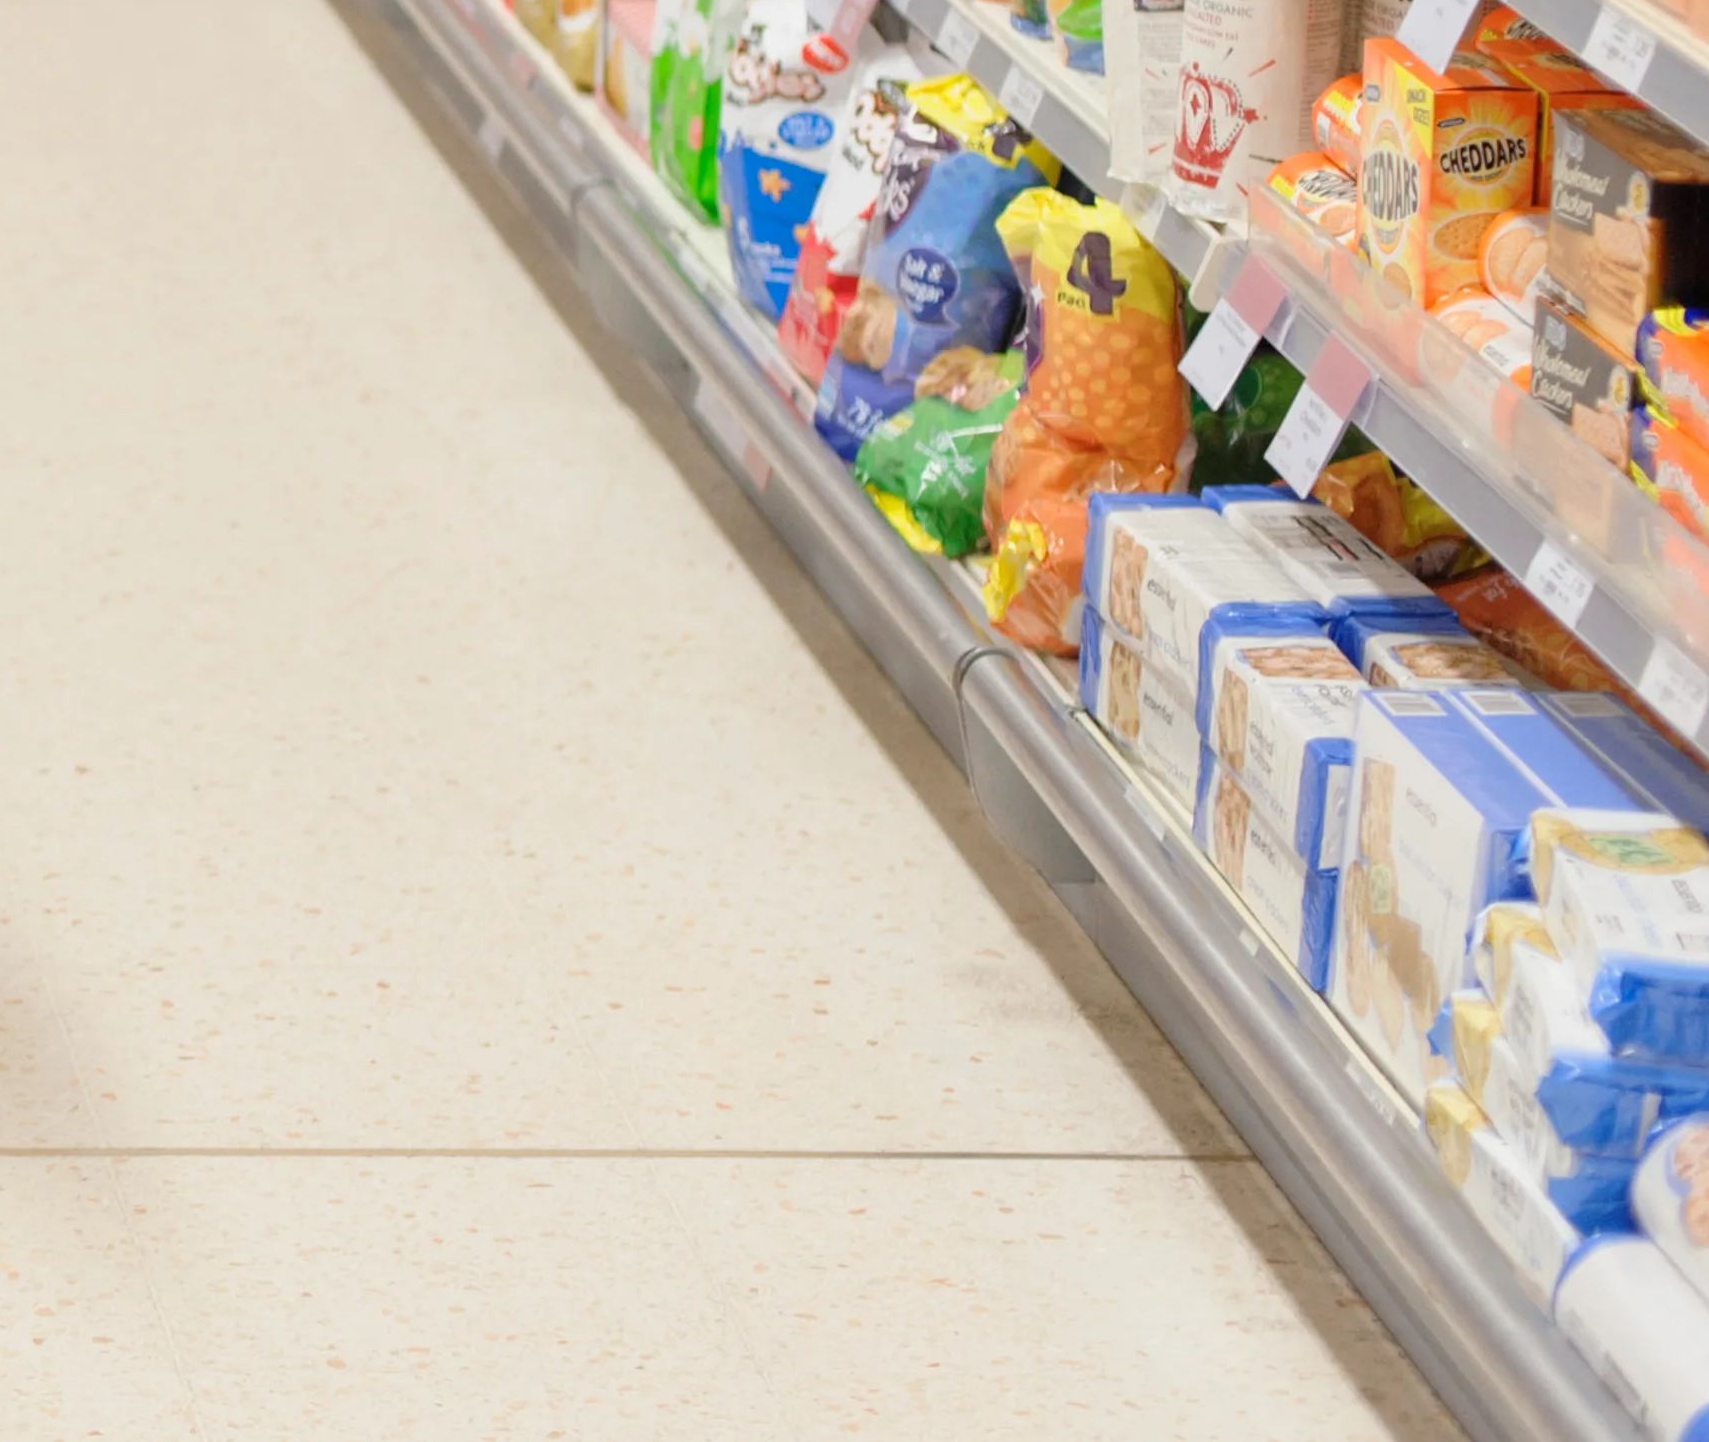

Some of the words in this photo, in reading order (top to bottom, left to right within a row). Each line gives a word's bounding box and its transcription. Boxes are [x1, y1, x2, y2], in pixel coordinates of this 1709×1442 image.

[1363, 149, 1419, 222] CHEDDARS
[1439, 137, 1527, 175] CHEDDARS
[1067, 231, 1127, 316] 4
